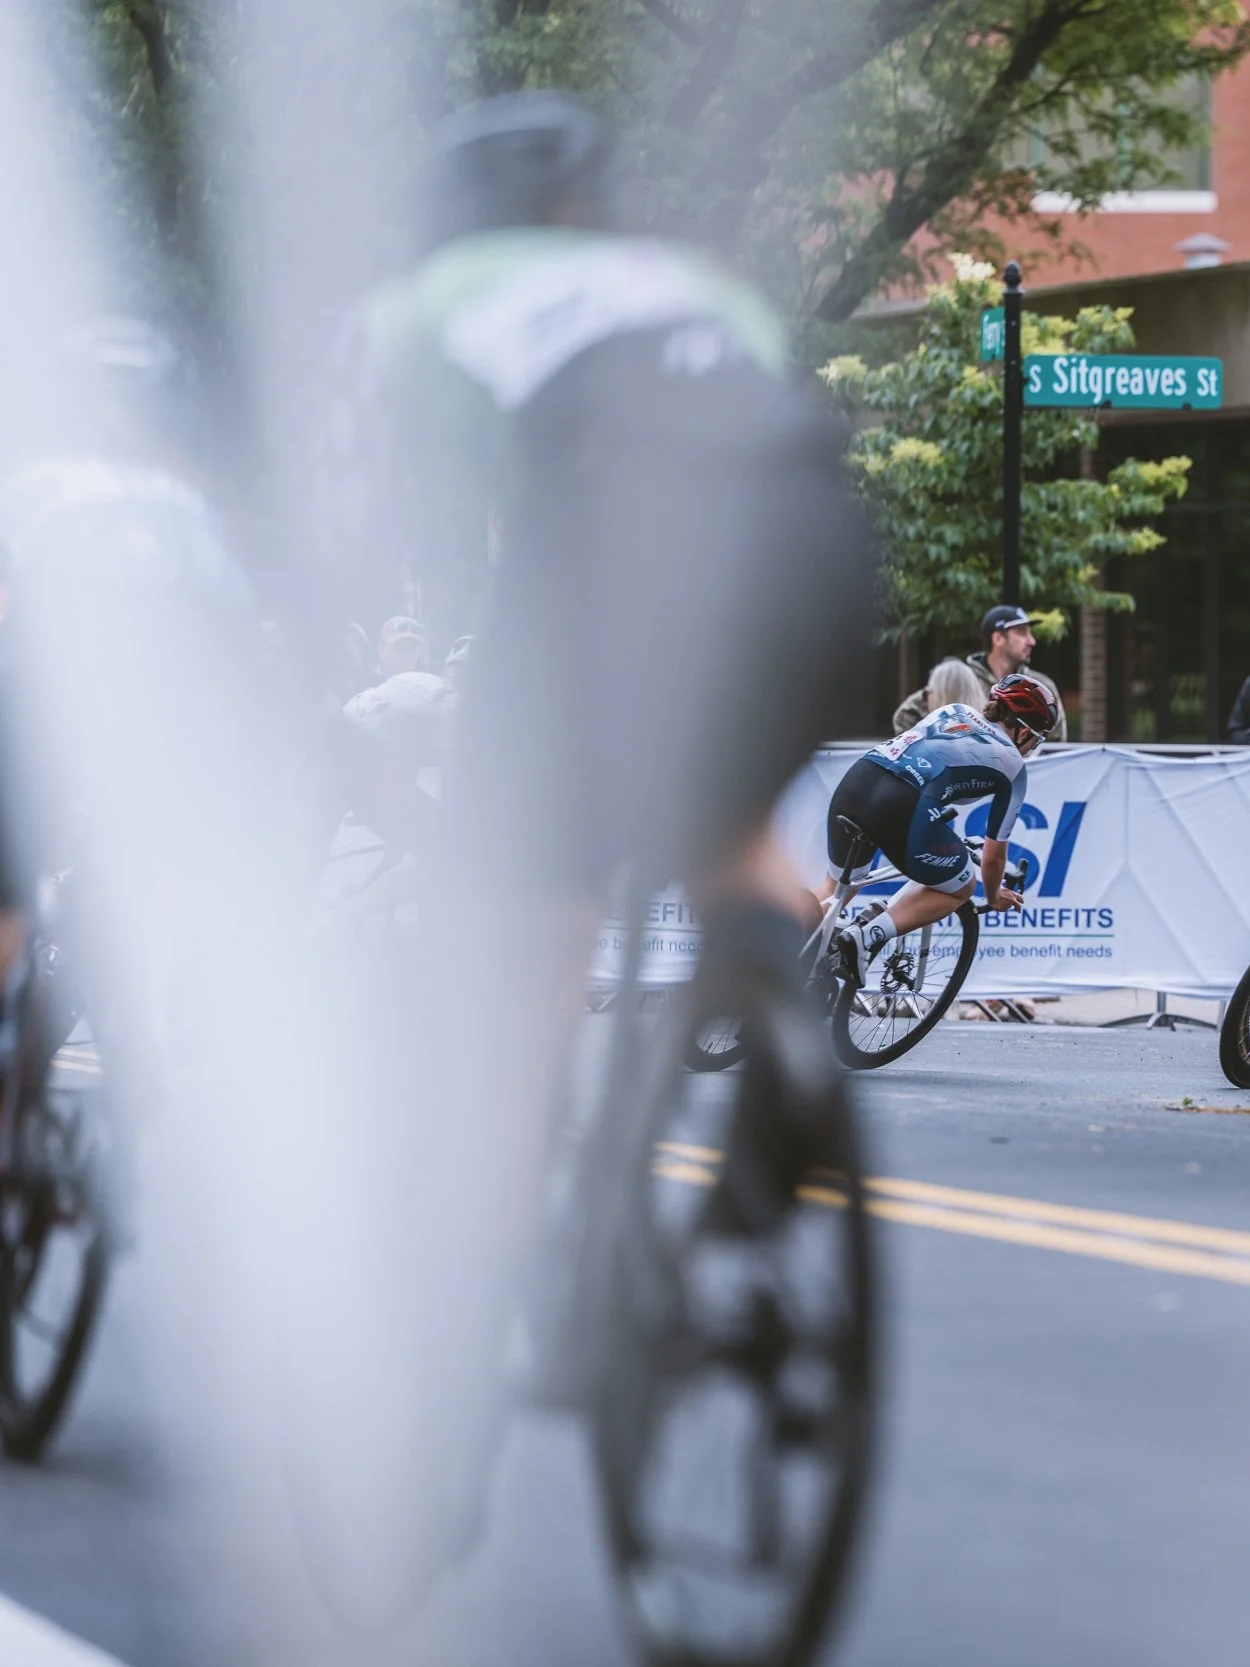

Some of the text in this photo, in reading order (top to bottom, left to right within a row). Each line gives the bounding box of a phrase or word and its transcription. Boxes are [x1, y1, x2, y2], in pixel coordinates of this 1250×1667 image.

[1053, 357, 1187, 404] Sitgreaves
[1197, 368, 1217, 396] St
[914, 853, 960, 867] FEMME
[985, 908, 1113, 929] BENEFITS
[1010, 943, 1061, 958] benefit
[1066, 944, 1113, 958] needs
